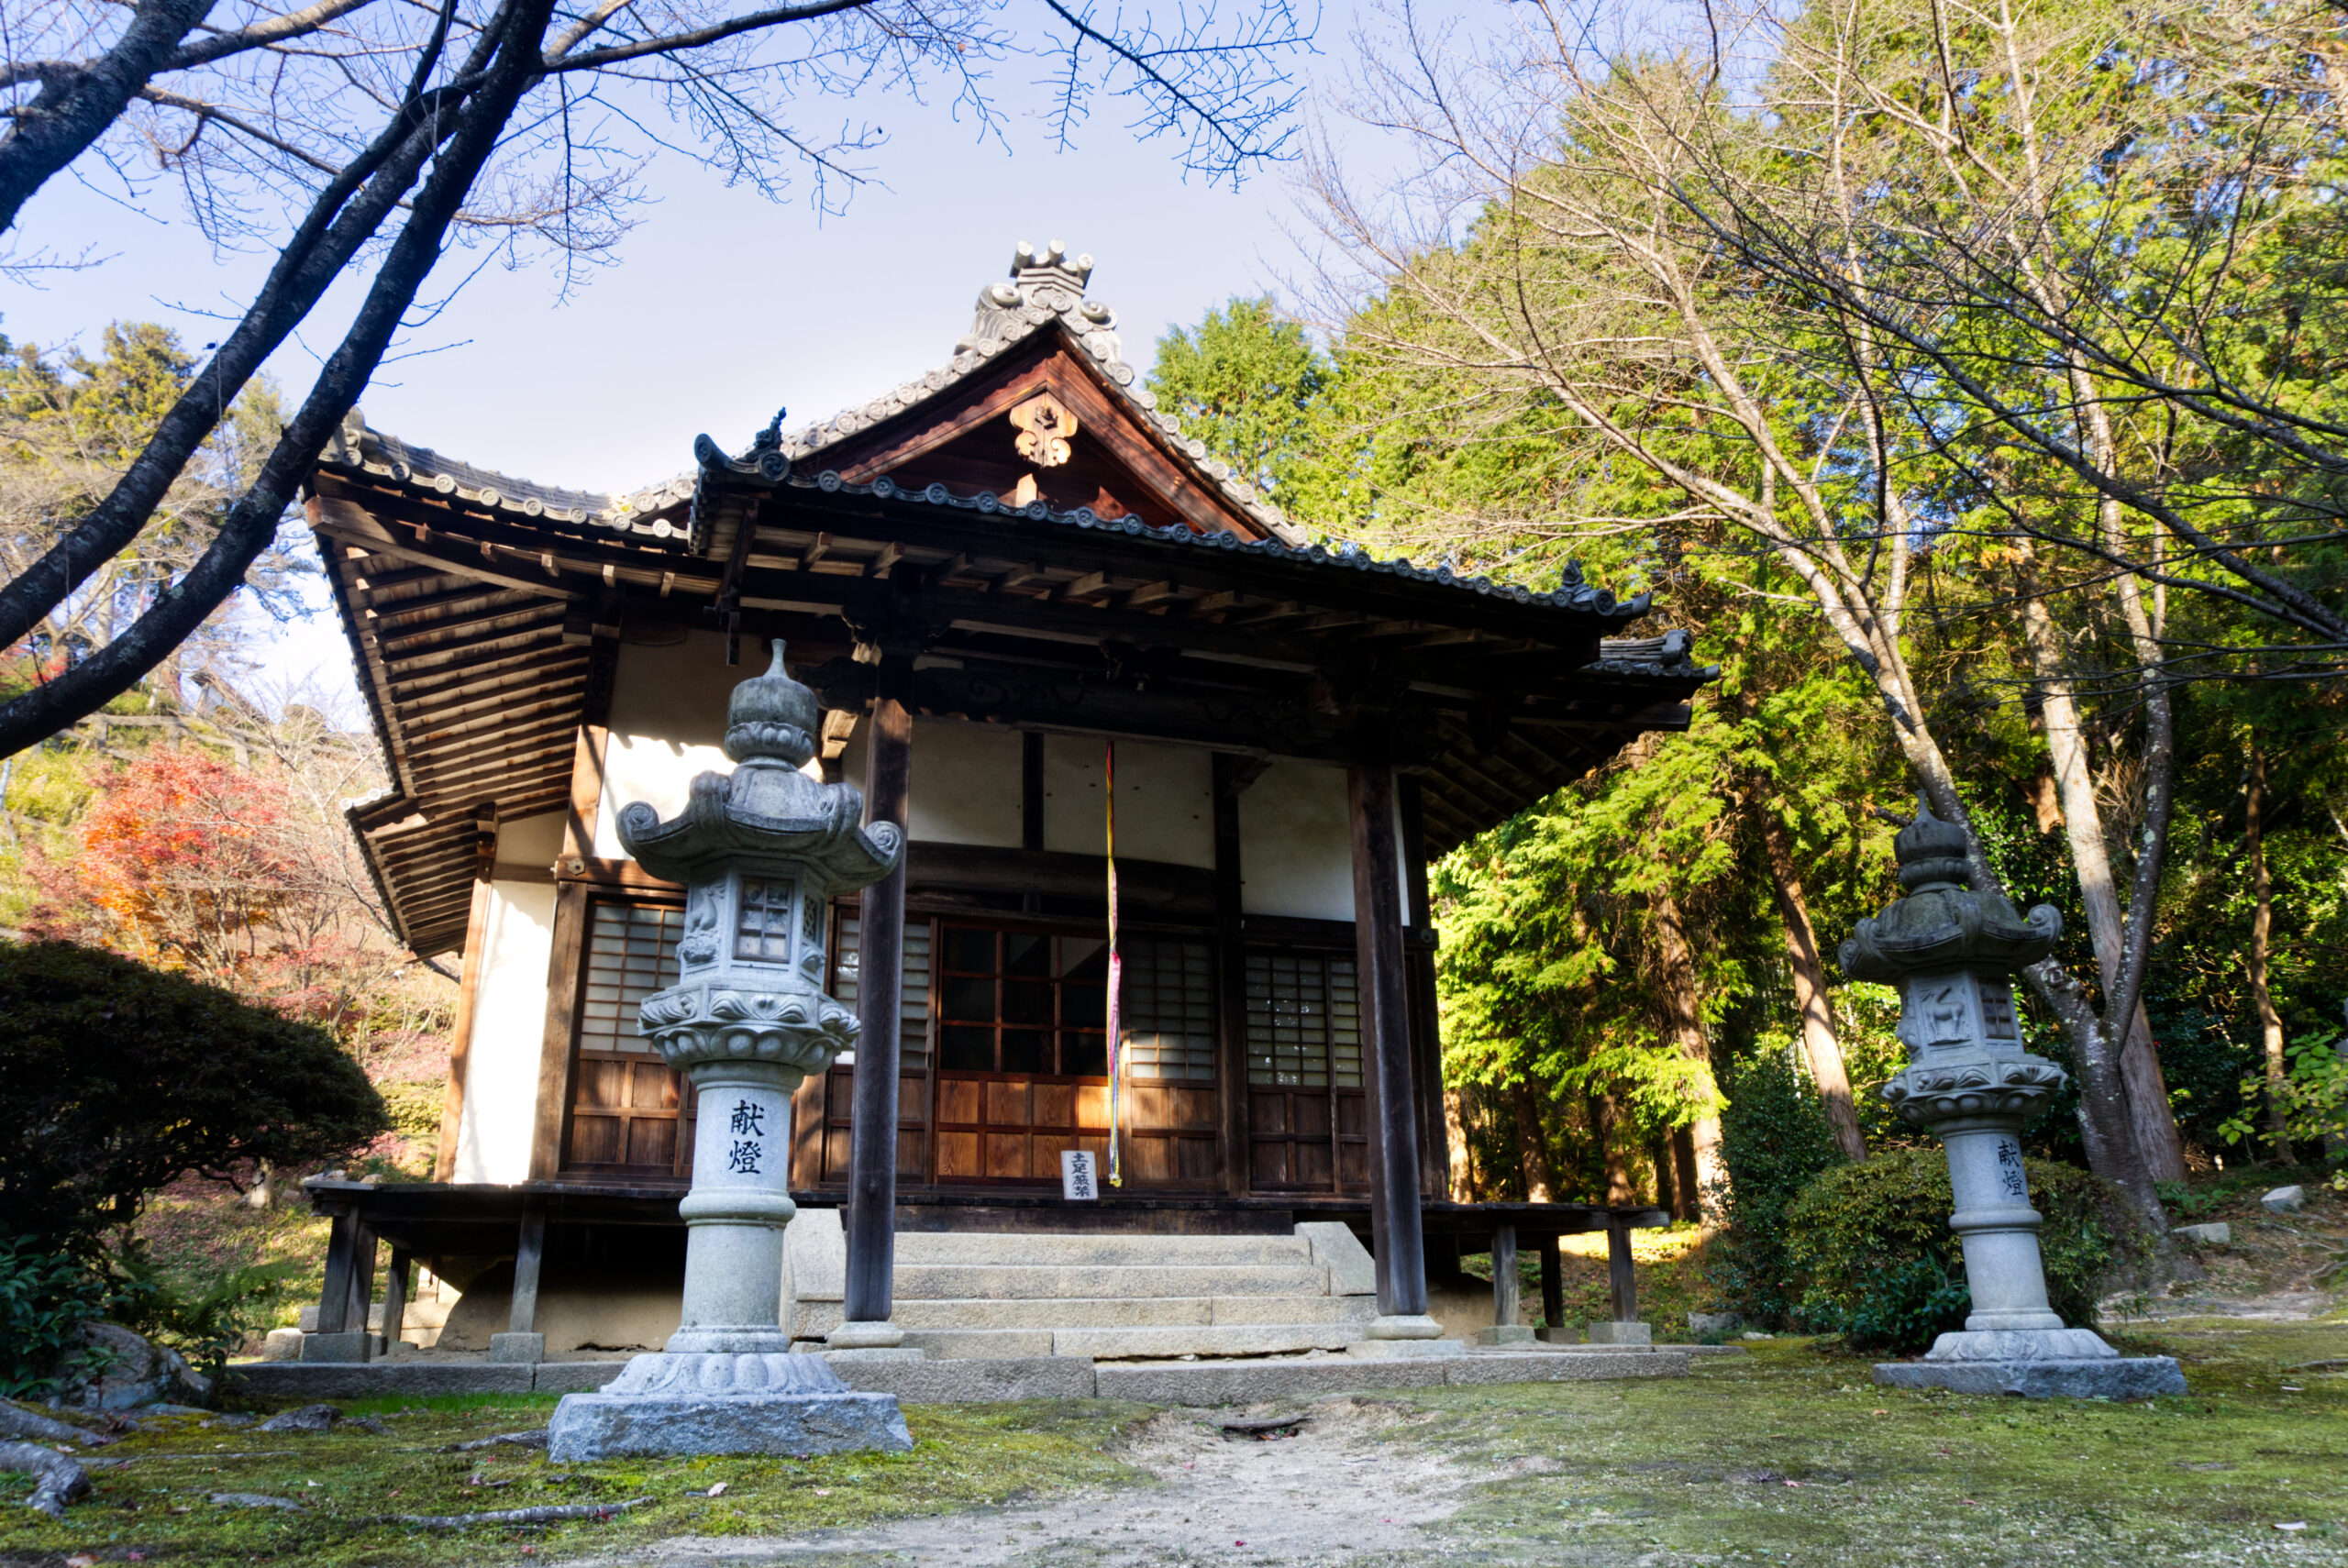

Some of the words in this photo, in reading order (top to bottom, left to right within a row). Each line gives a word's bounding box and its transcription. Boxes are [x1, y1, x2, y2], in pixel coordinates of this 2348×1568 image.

[728, 1099, 765, 1175] 献燈
[1071, 1153, 1091, 1197] 土足厳禁
[1998, 1140, 2023, 1196] 献燈
